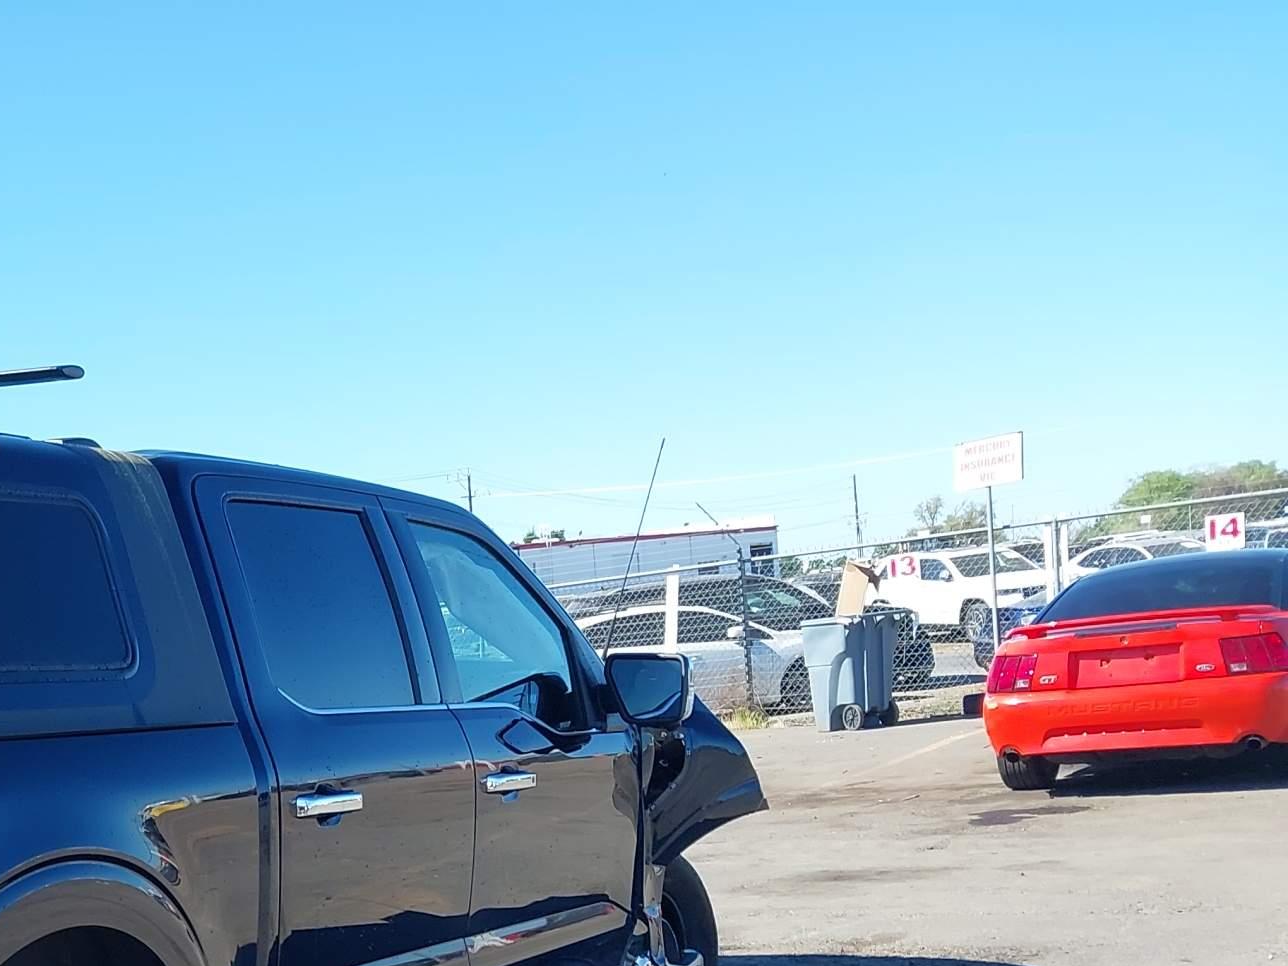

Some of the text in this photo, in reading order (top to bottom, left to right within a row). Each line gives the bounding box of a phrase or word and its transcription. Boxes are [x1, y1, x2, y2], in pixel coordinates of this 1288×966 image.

[1210, 517, 1241, 541] 14
[890, 555, 917, 578] 13
[1039, 674, 1059, 685] GT
